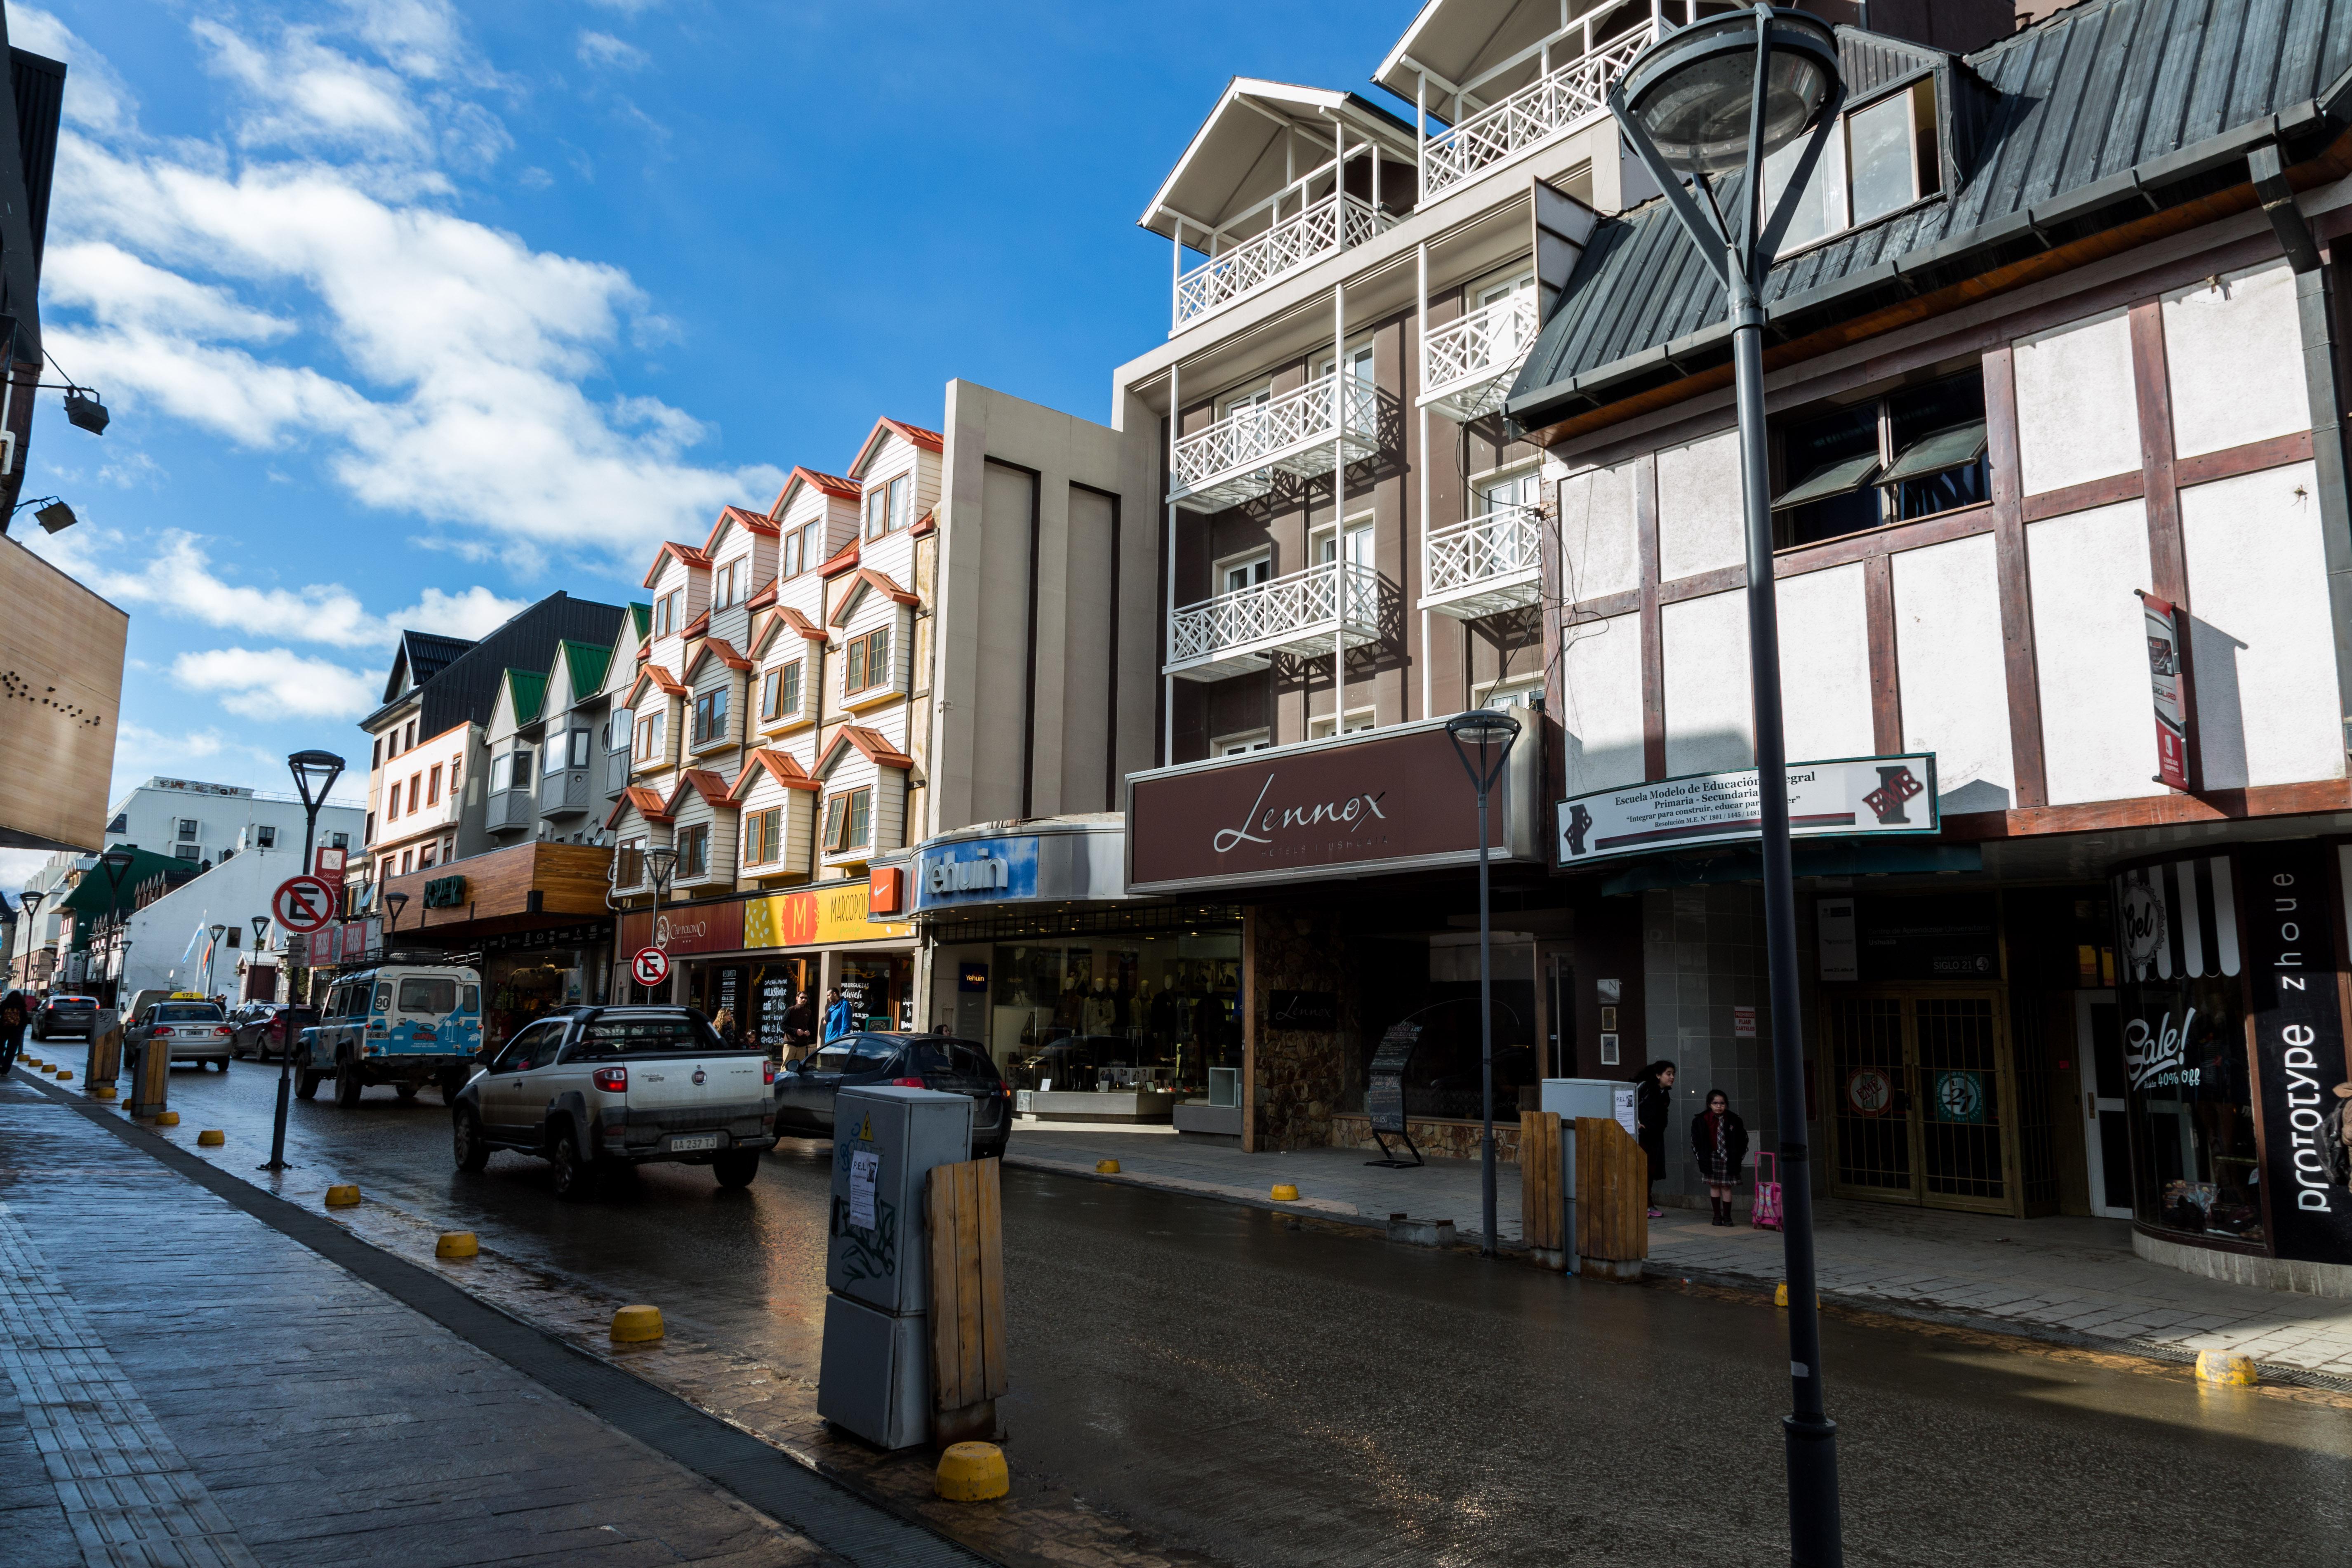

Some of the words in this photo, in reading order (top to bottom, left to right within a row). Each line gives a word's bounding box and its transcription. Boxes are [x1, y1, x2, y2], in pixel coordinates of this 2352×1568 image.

[1615, 793, 1648, 805] Escuela
[1650, 786, 1685, 800] Modelo
[1688, 784, 1700, 793] de
[1702, 777, 1759, 791] Educación
[1655, 797, 1694, 809] Primaria
[1702, 789, 1758, 803] Secundaria
[1214, 773, 1387, 852] Lennox
[1657, 811, 1674, 819] para
[1676, 805, 1713, 815] construir,
[1715, 803, 1743, 811] educar
[1655, 819, 1685, 827] Resolución
[1261, 845, 1306, 858] HOTELS
[1328, 836, 1388, 850] USHUAIA
[922, 848, 1008, 894] Yehuin
[793, 897, 806, 937] M
[2124, 902, 2153, 949] Gel
[1902, 925, 1944, 935] Aprendizaje
[1933, 961, 1959, 970] SIGLO
[1961, 961, 1973, 969] 21
[1609, 980, 1617, 990] N
[377, 998, 389, 1008] 90
[1275, 995, 1331, 1020] Lennox
[2158, 1072, 2179, 1088] 40%
[673, 1141, 683, 1150] AA
[687, 1139, 702, 1149] 237
